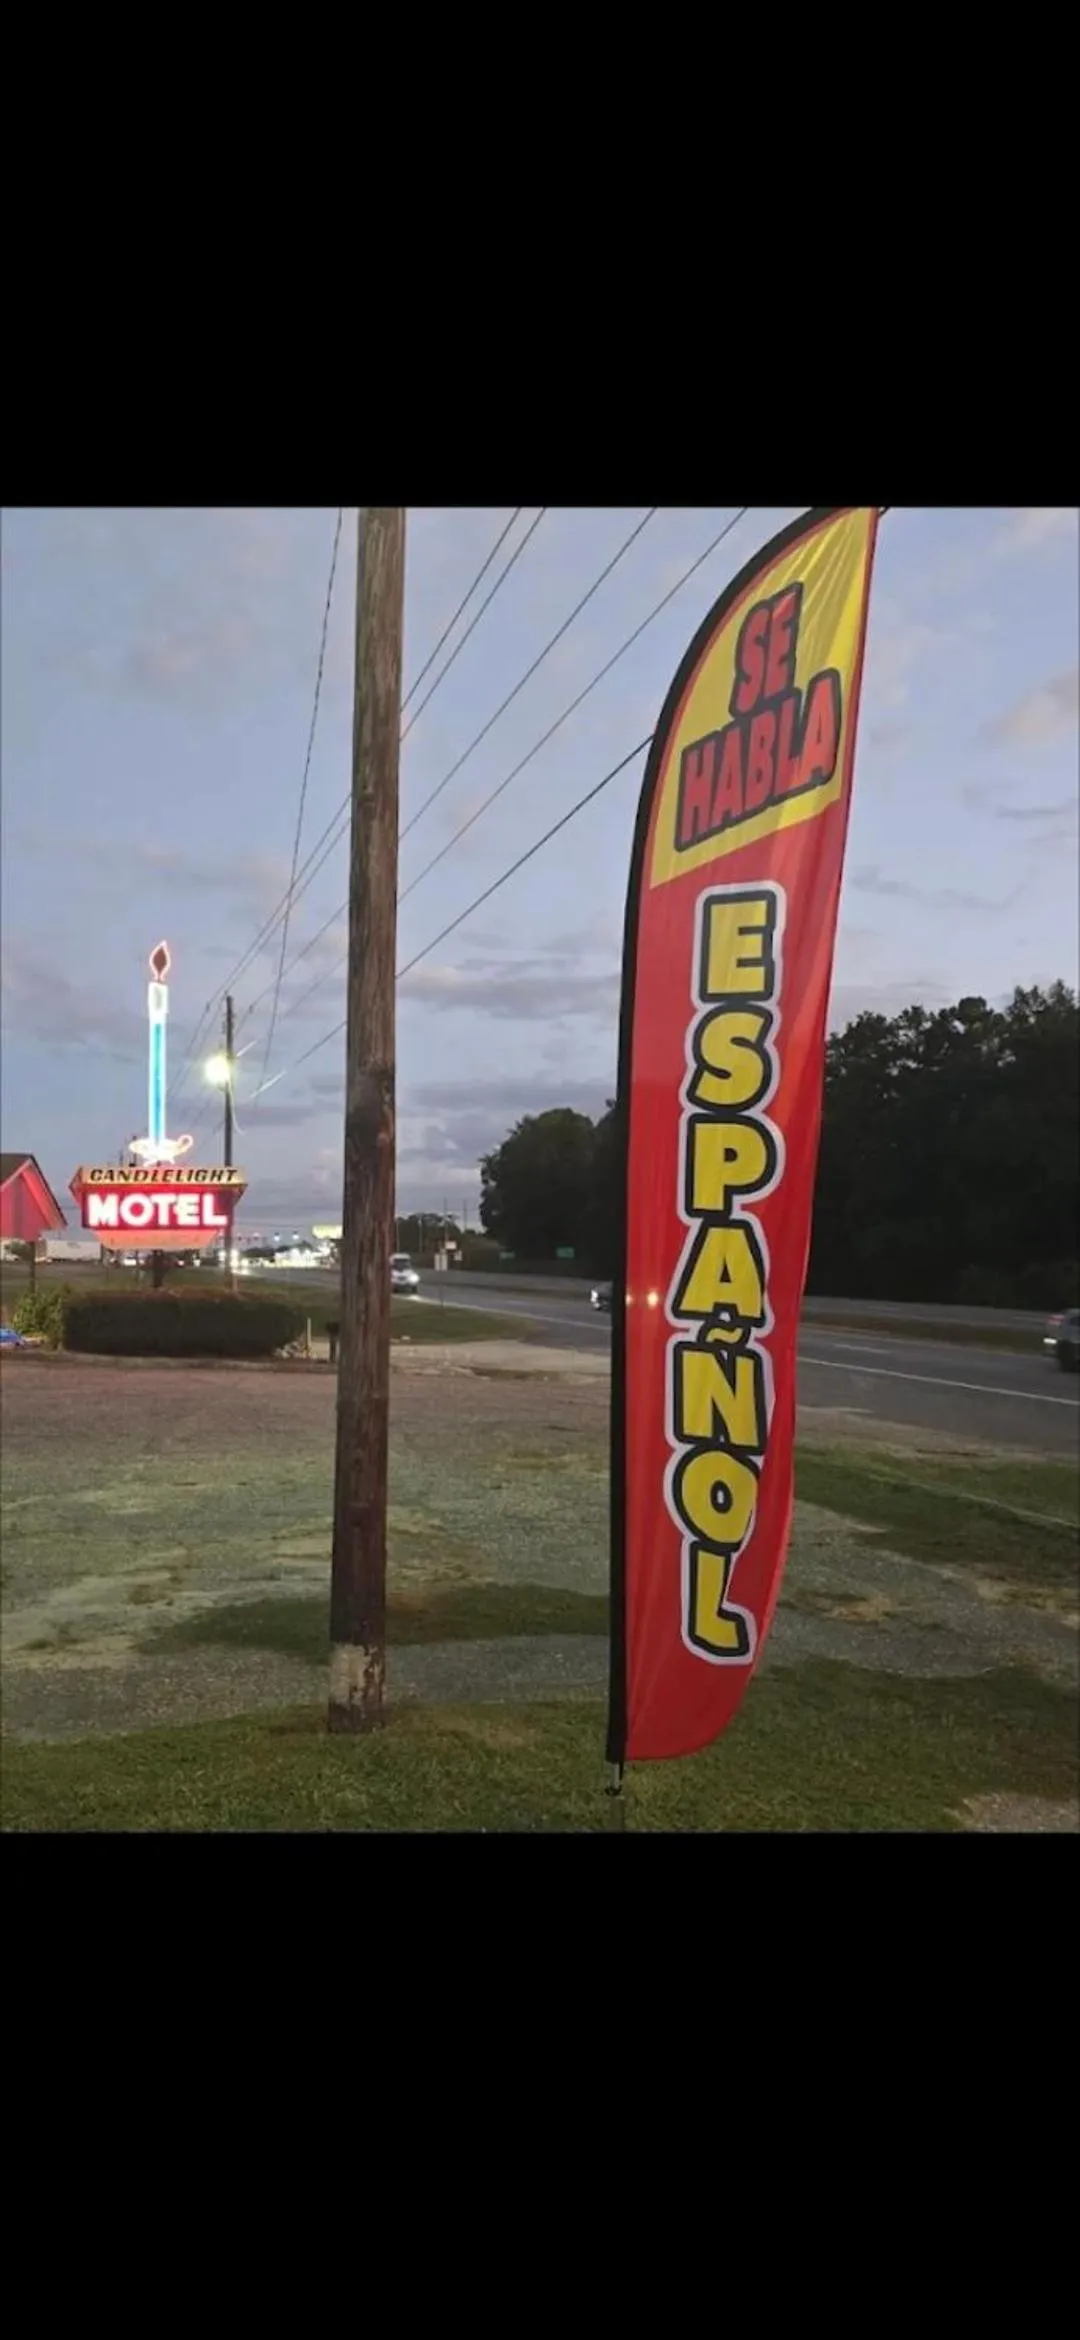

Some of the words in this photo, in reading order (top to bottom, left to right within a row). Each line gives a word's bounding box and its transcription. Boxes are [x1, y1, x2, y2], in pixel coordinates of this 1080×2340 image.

[731, 583, 803, 717] SE
[675, 668, 841, 852] HABLA
[87, 1193, 229, 1227] MOTEL
[90, 1168, 238, 1182] CANDLELIGHT
[667, 886, 785, 1660] ESPAÑOL
